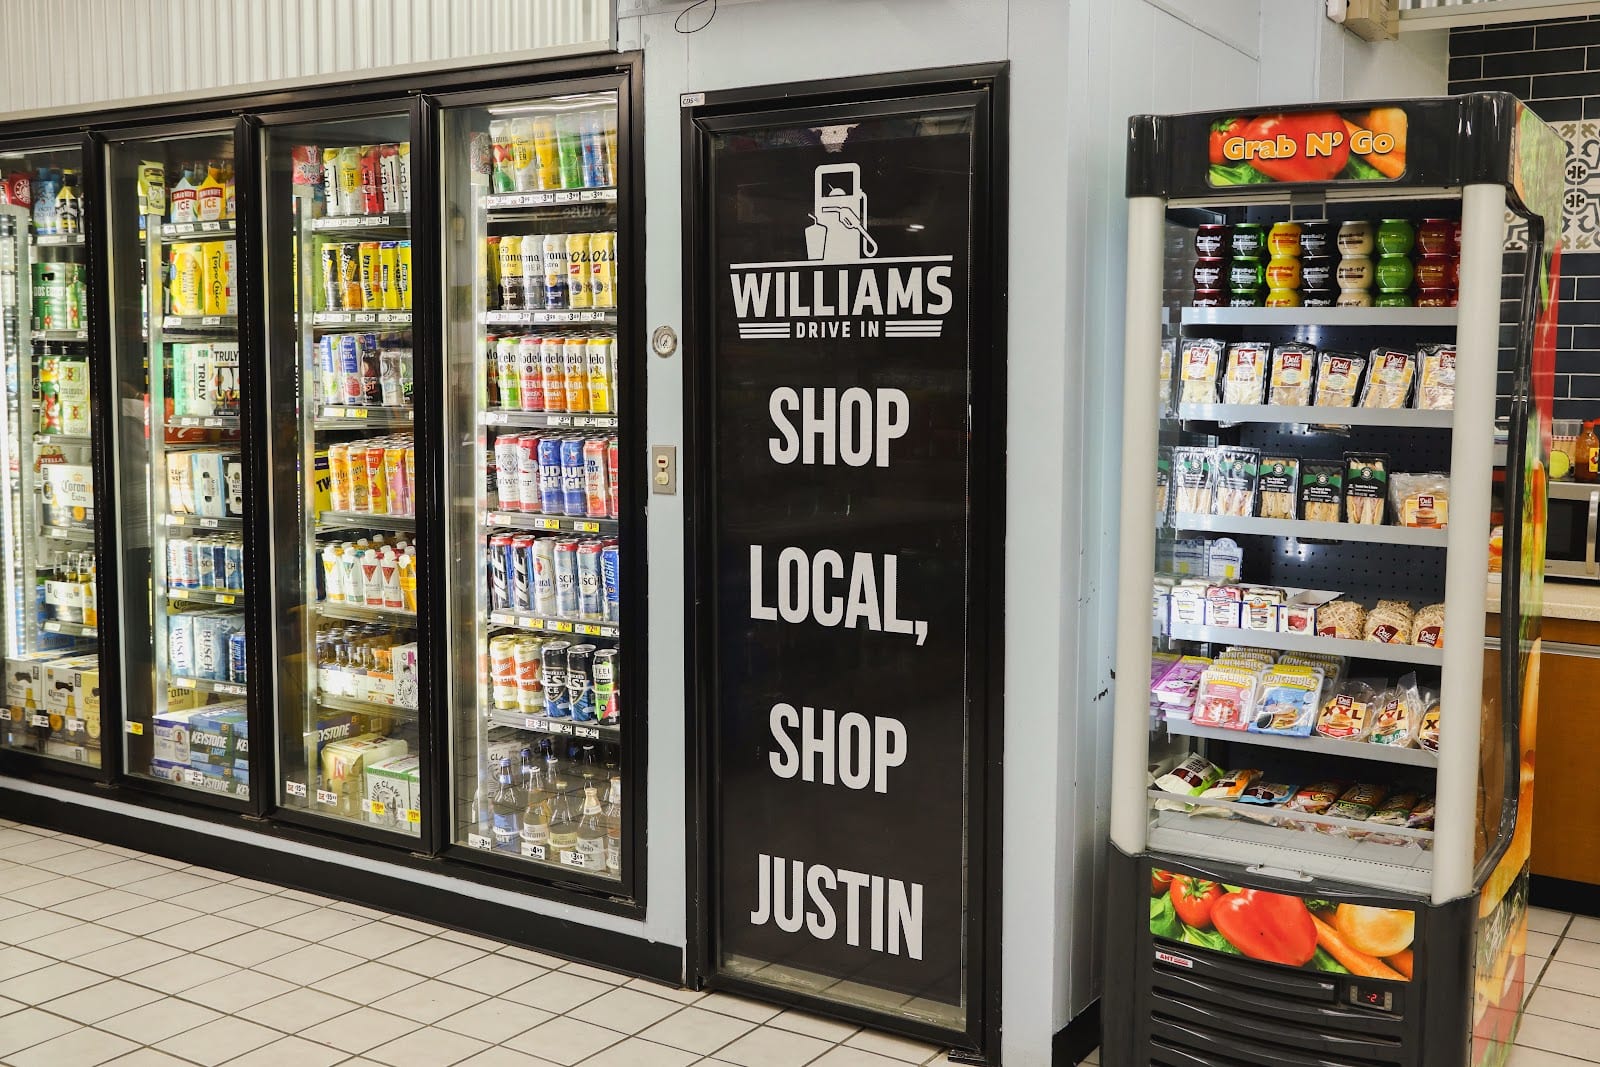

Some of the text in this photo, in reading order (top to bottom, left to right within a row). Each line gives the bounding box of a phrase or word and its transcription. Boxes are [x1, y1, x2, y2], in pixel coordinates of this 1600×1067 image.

[1223, 134, 1297, 161] Grab
[1350, 130, 1395, 155] Go
[177, 200, 190, 210] ICE
[204, 199, 216, 208] ICE
[730, 265, 953, 318] WILLIAMS
[796, 320, 879, 338] DRIVE IN
[214, 350, 240, 362] TRULY
[1331, 359, 1348, 369] Deli
[198, 363, 206, 401] TRULY
[769, 387, 910, 468] SHOP
[751, 545, 928, 646] LOCAL,
[203, 630, 213, 671] BUSCH
[1323, 706, 1363, 721] XXL
[191, 730, 228, 749] KEYSTONE
[211, 747, 226, 757] LIGHT
[770, 703, 908, 793] SHOP
[751, 854, 923, 960] JUSTIN
